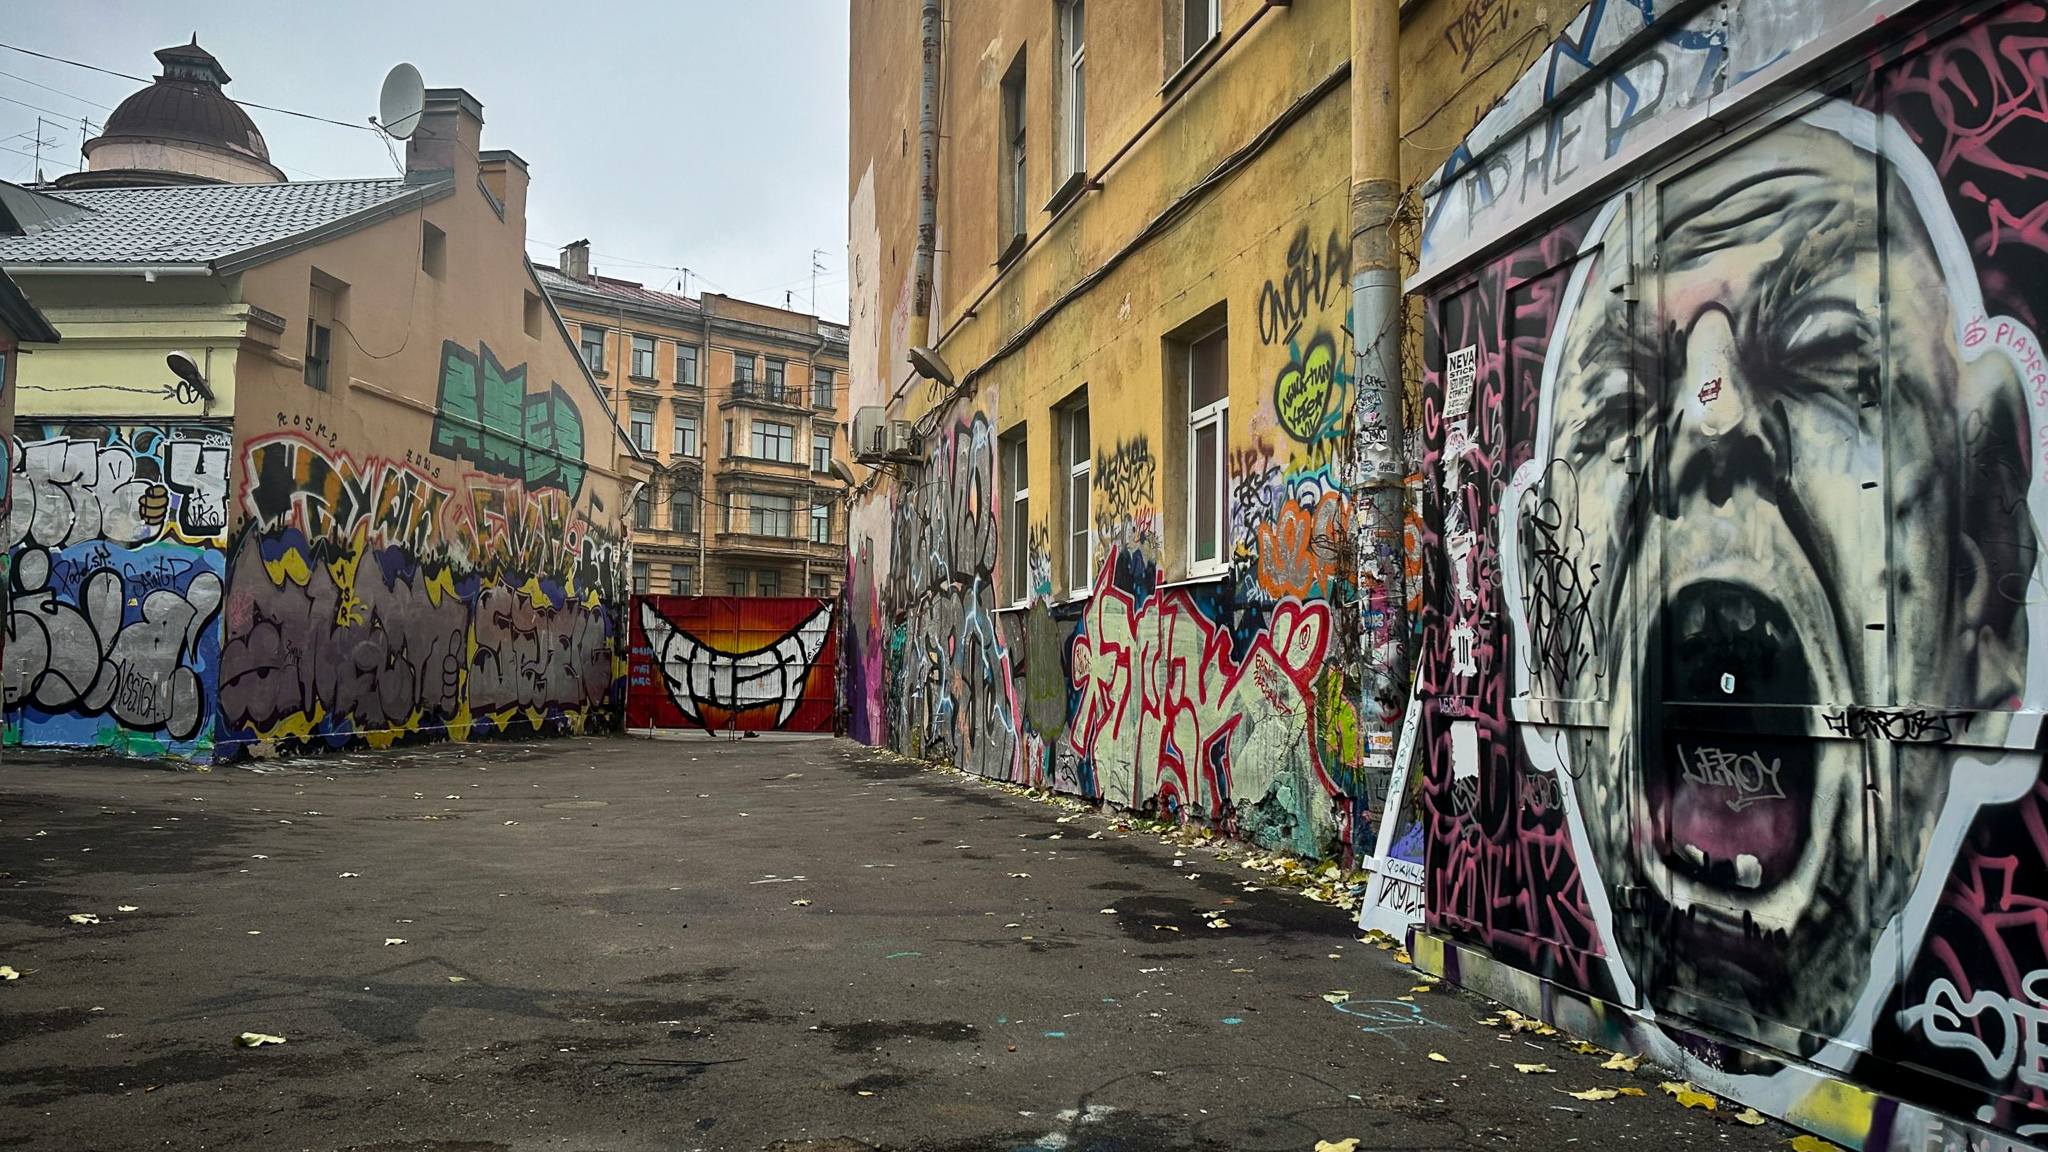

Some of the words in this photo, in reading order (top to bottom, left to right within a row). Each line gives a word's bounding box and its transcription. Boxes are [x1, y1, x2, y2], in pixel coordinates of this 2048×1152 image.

[1449, 350, 1475, 372] NEVA
[1449, 366, 1475, 379] STICK
[1677, 743, 1786, 800] LEROY
